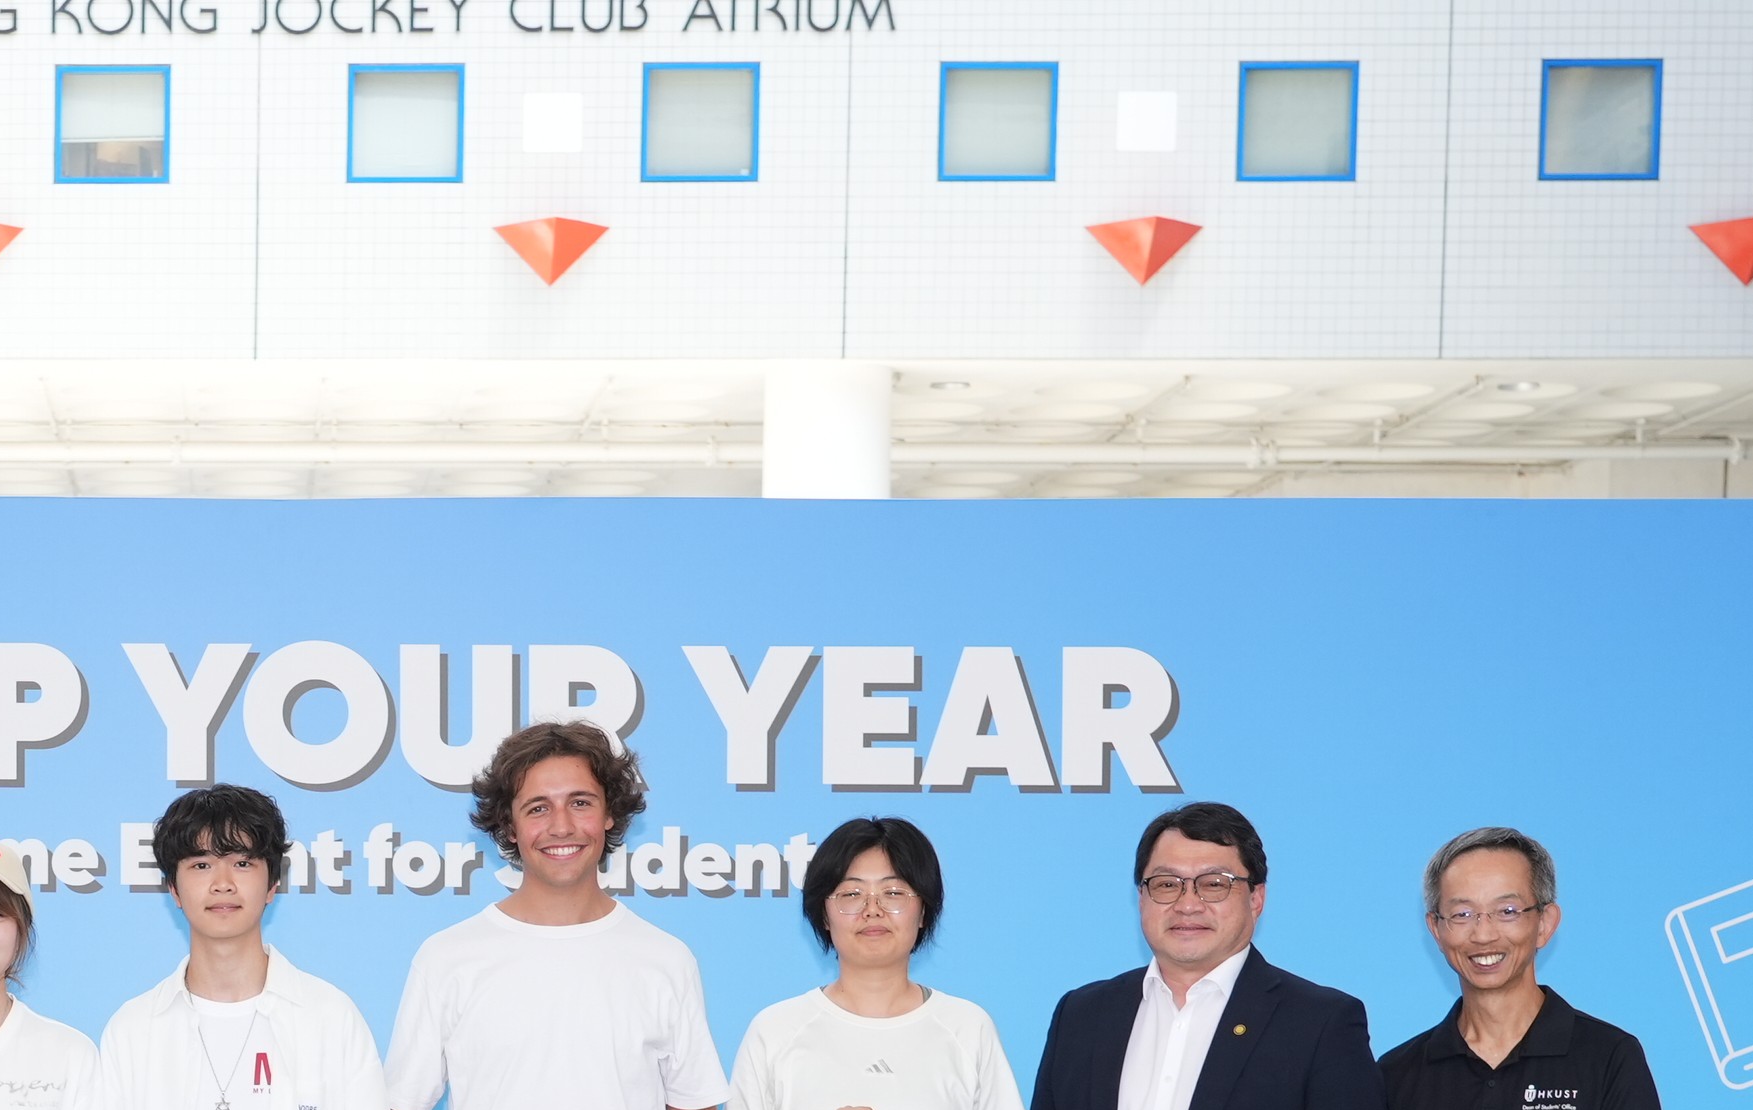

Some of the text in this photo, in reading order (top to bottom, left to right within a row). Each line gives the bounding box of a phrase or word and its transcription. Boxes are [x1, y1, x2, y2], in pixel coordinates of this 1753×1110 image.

[50, 0, 218, 35] KONG
[250, 0, 468, 35] JOCKEY
[509, 0, 650, 35] CLUB
[120, 639, 646, 788] YOUR
[681, 644, 1178, 791] YEAR
[119, 821, 346, 891] Ent
[362, 820, 478, 890] for
[1537, 1089, 1578, 1099] HKUST
[1561, 1103, 1577, 1110] Office
